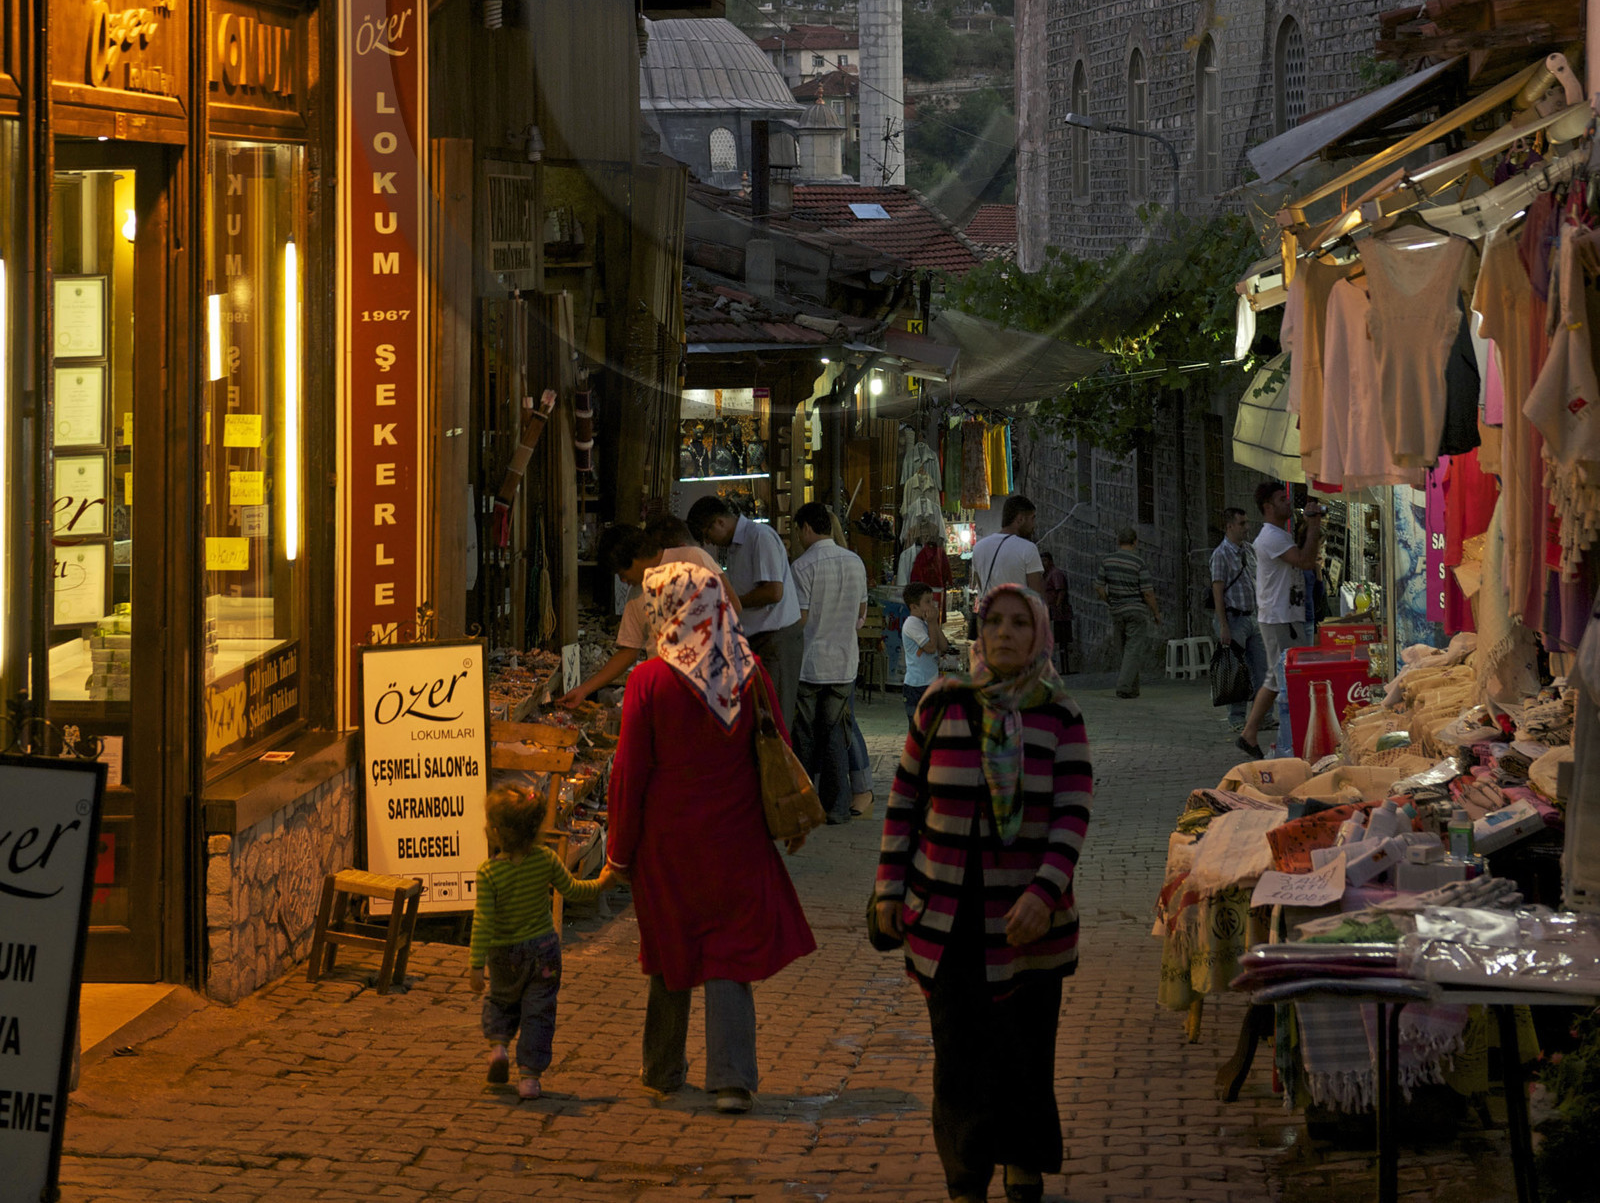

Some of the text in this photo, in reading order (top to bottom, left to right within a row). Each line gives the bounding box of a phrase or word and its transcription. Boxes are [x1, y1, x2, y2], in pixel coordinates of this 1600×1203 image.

[357, 9, 412, 57] Özer
[373, 91, 400, 275] LOKUM
[360, 310, 412, 322] 1967
[374, 670, 468, 725] Özer
[411, 728, 475, 741] LOKUMLARI
[372, 753, 421, 786] ÇEŞMELİ
[388, 795, 464, 820] SAFRANBOLU
[398, 831, 460, 859] BELGESELİ
[433, 879, 458, 887] wireless
